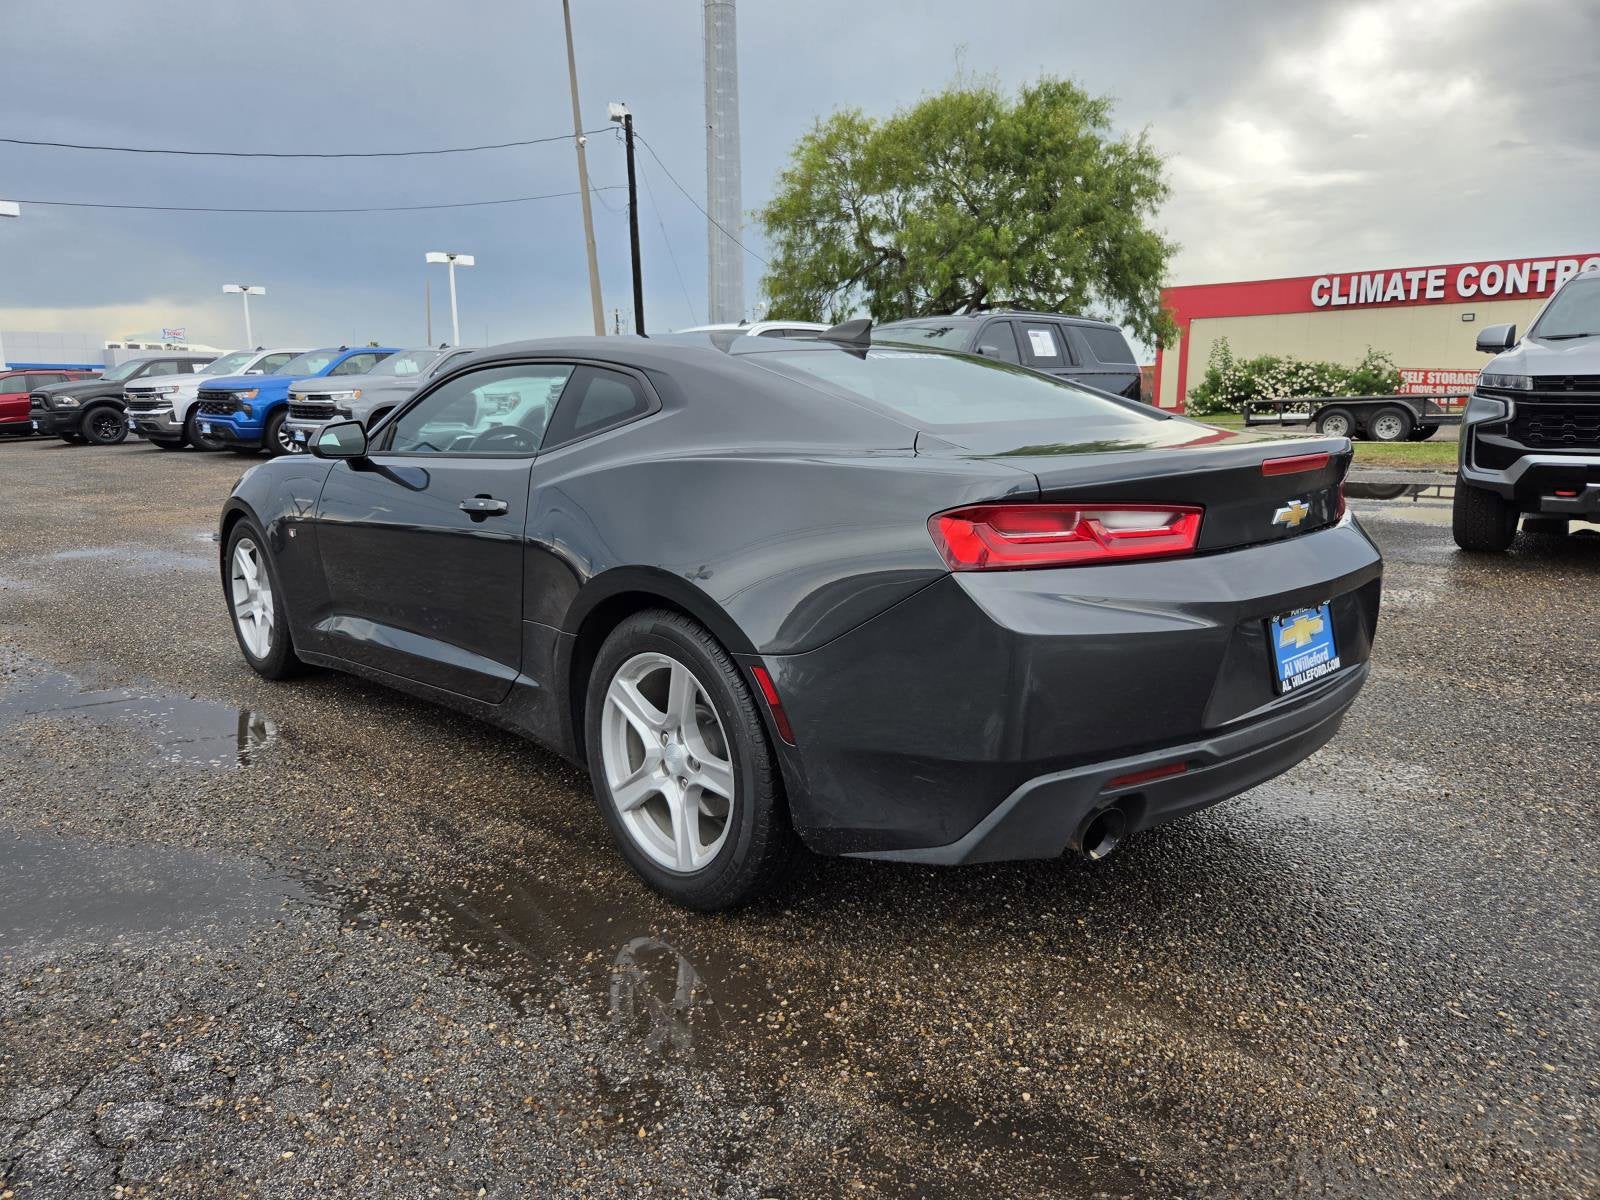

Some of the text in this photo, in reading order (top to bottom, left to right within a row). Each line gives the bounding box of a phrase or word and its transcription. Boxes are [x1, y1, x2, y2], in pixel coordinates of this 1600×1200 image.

[1311, 268, 1447, 307] CLIMATE
[1401, 371, 1479, 385] SELF STORAGE
[1411, 385, 1445, 394] MOVE-IN
[1446, 386, 1476, 395] SPECIA
[1284, 648, 1329, 678] Al Willeford
